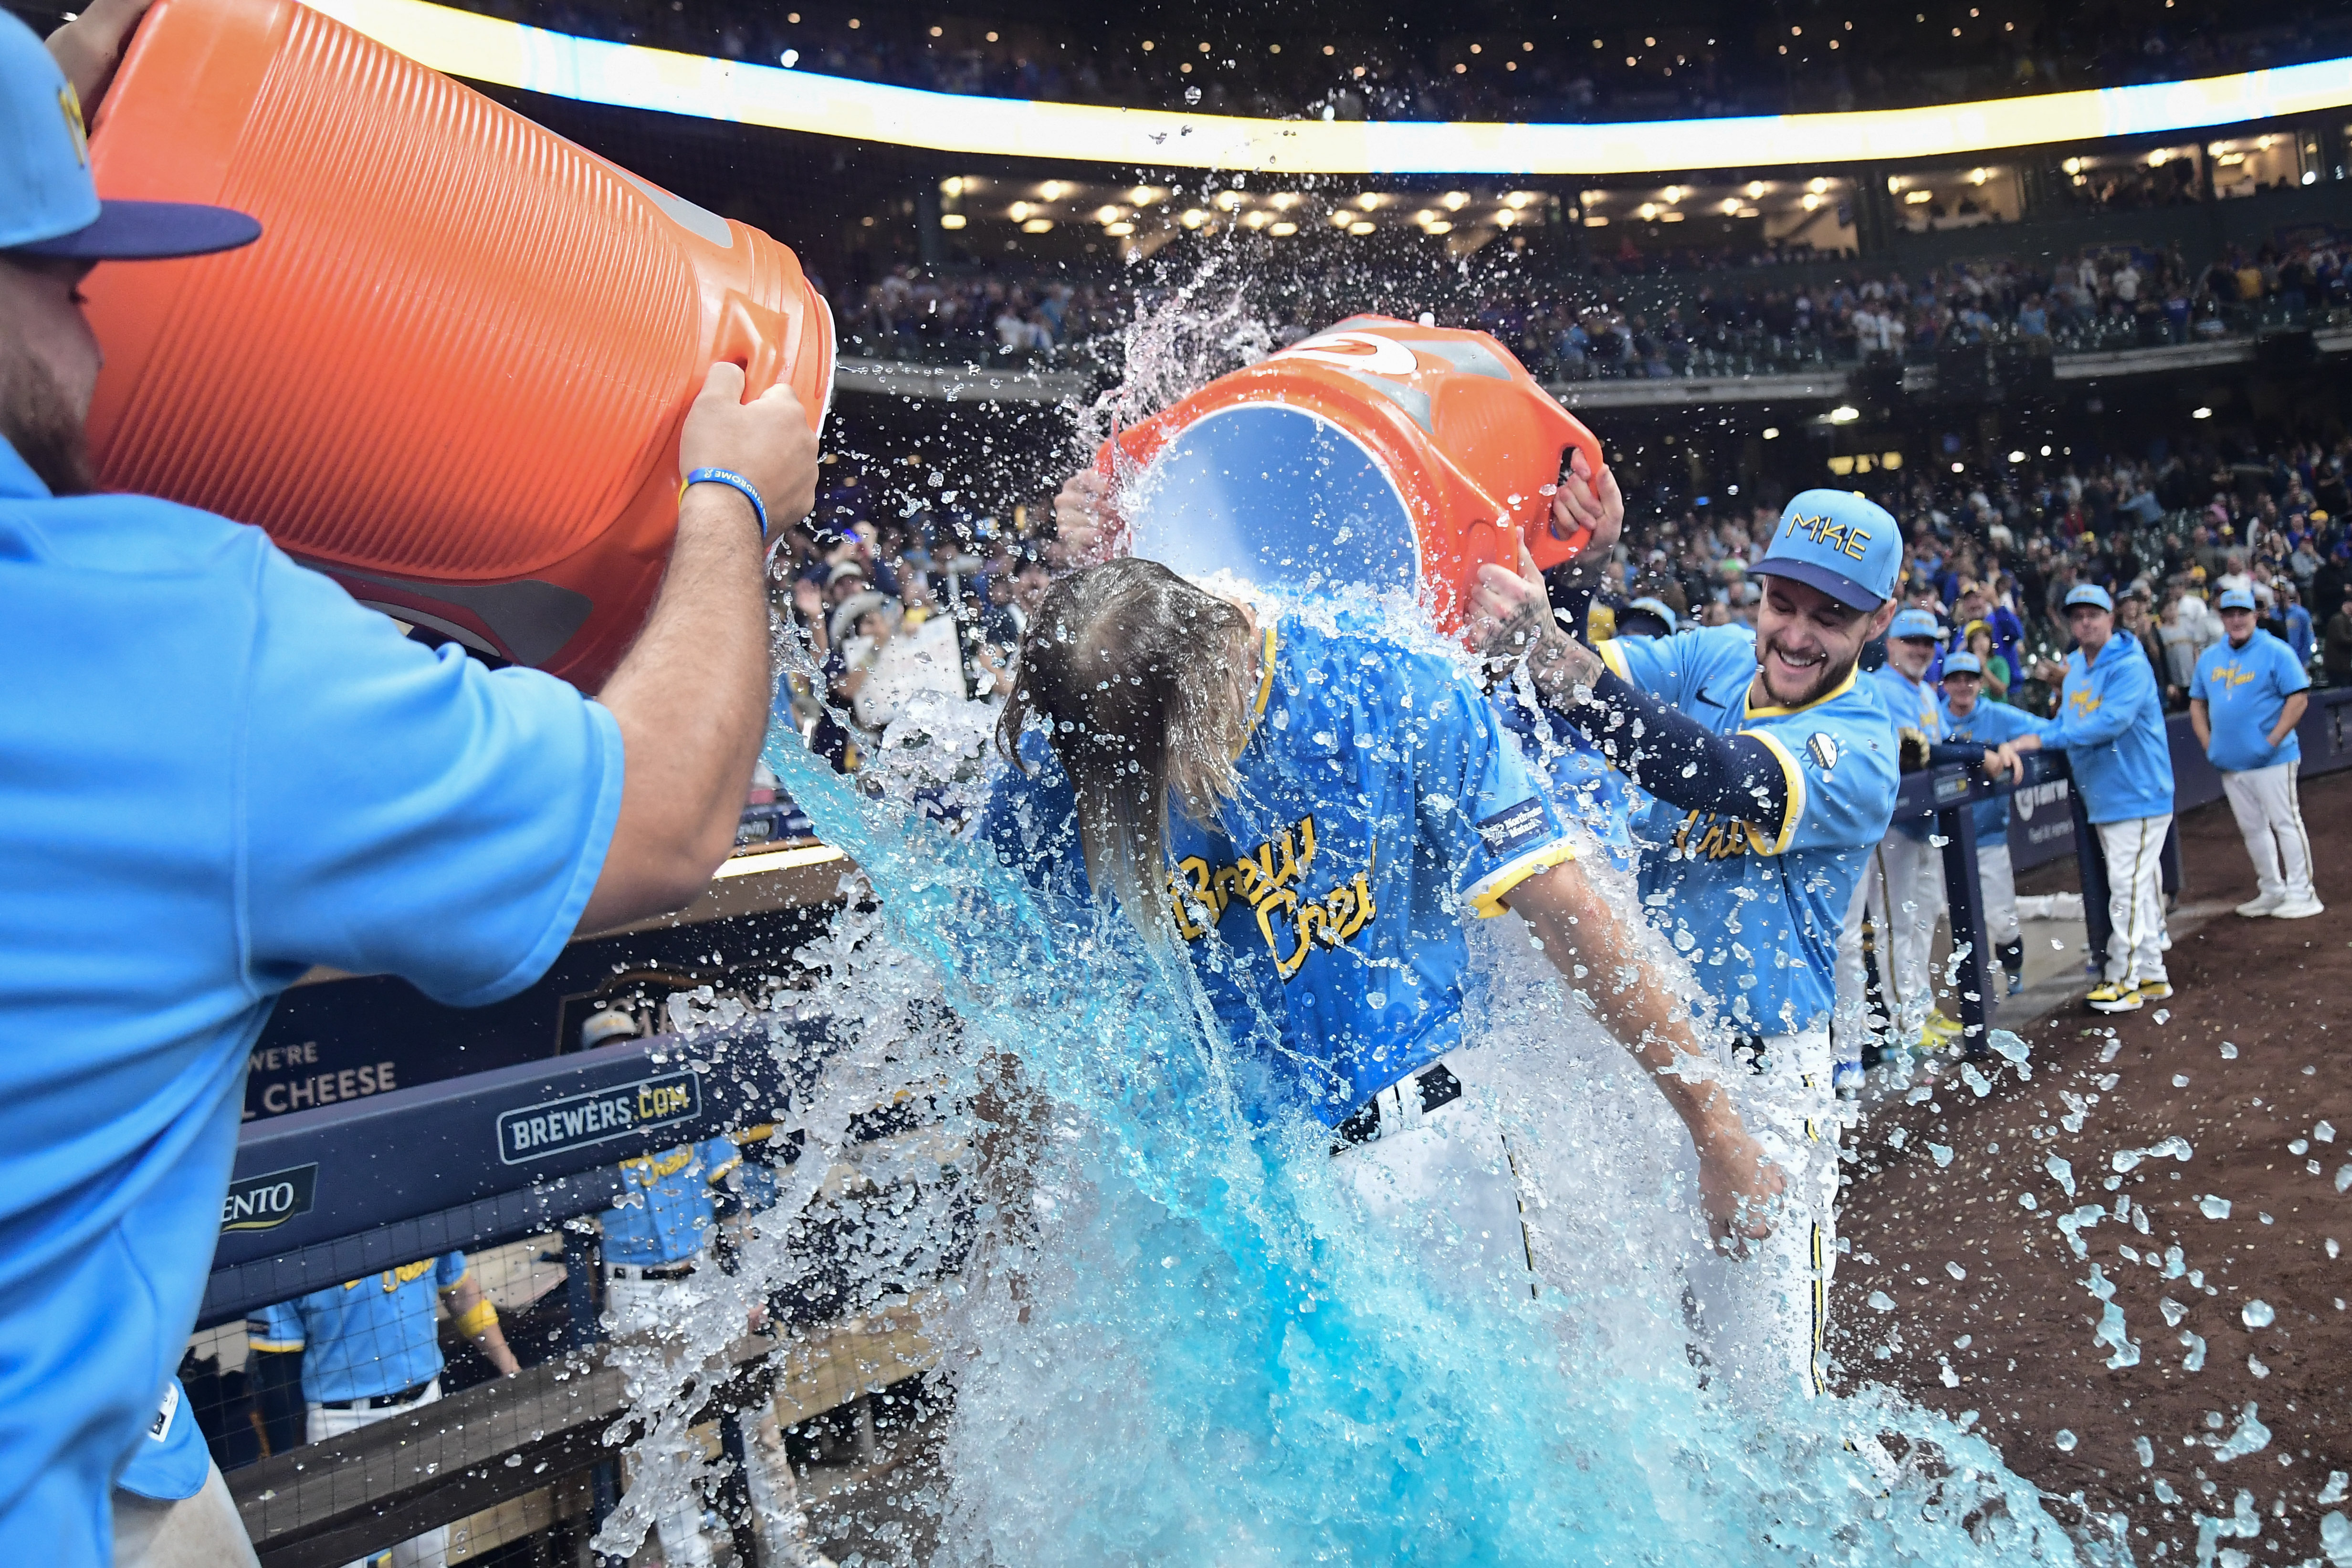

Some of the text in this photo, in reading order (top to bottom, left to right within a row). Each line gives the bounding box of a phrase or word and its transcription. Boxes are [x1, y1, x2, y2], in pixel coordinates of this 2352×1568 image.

[1785, 512, 1871, 561] MKE
[262, 1061, 397, 1114] CHEESE
[512, 1083, 689, 1151] BREWERS.COM
